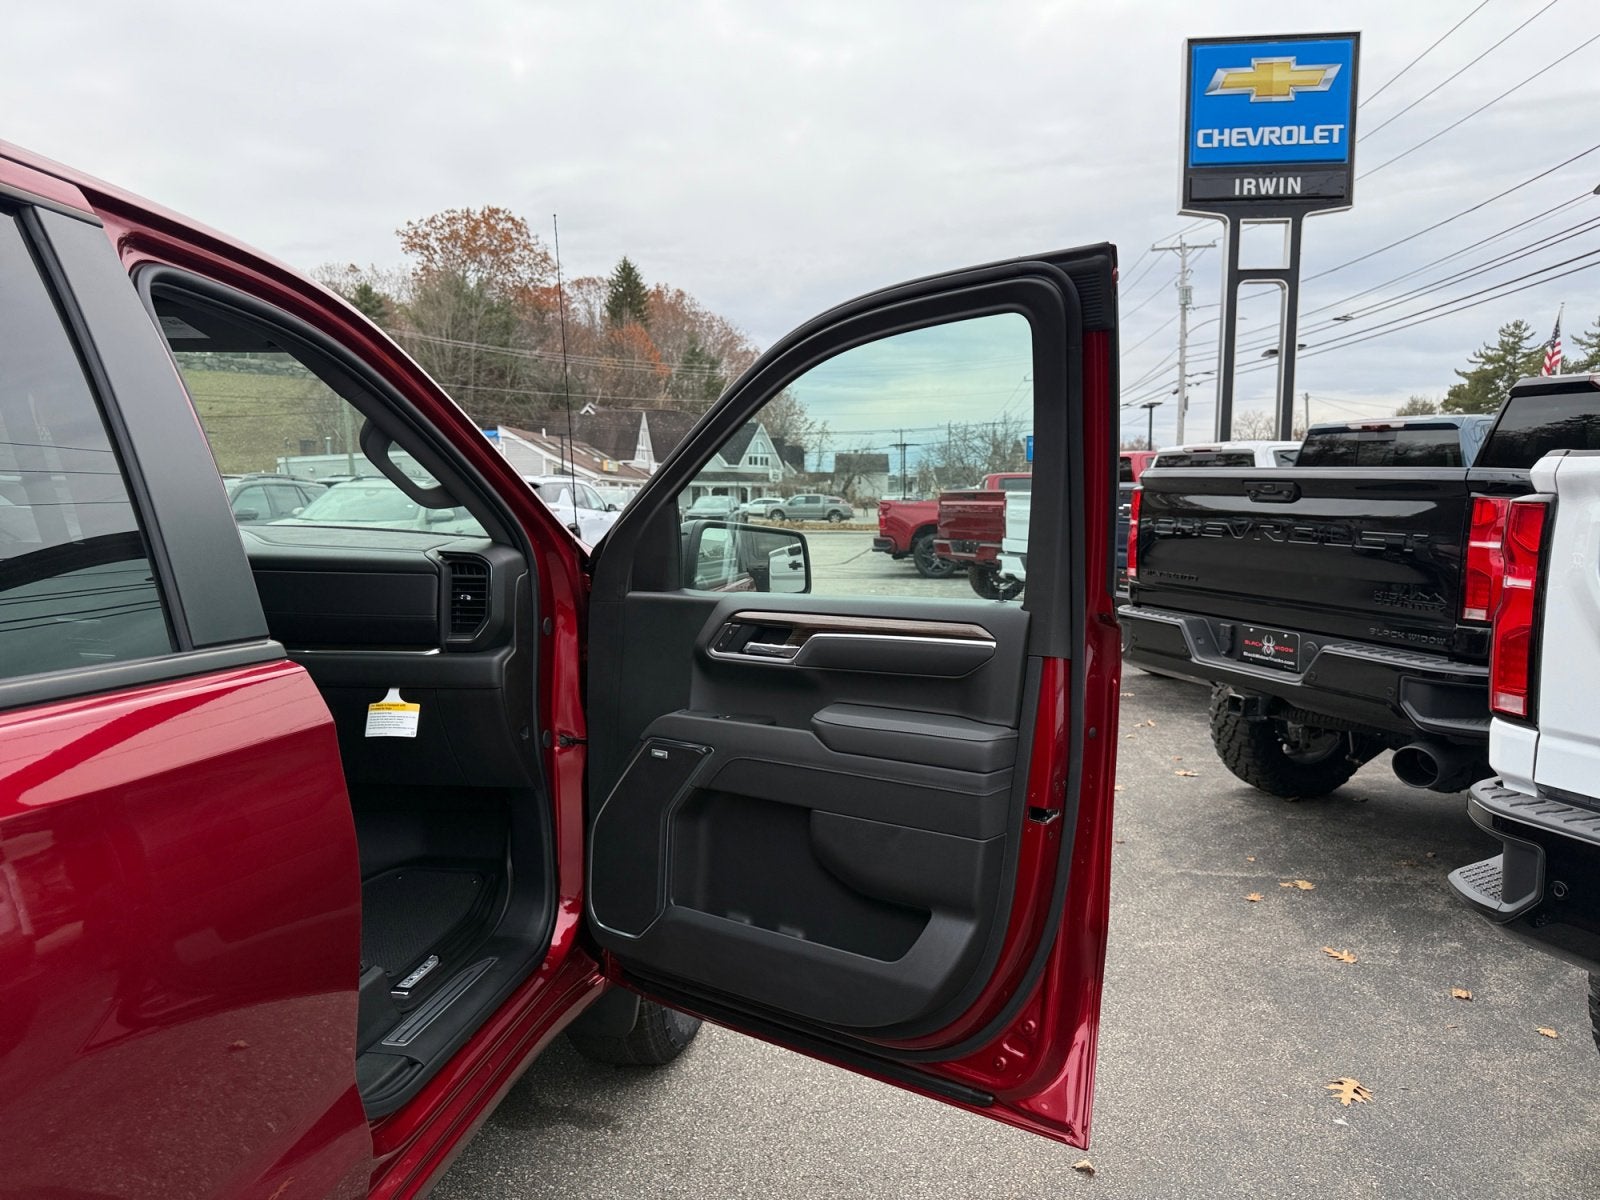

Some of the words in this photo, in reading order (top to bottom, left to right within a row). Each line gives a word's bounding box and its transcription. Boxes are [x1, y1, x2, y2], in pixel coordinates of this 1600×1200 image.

[1196, 124, 1344, 148] CHEVROLET
[1234, 176, 1302, 196] IRWIN
[1407, 632, 1447, 645] WIDOW
